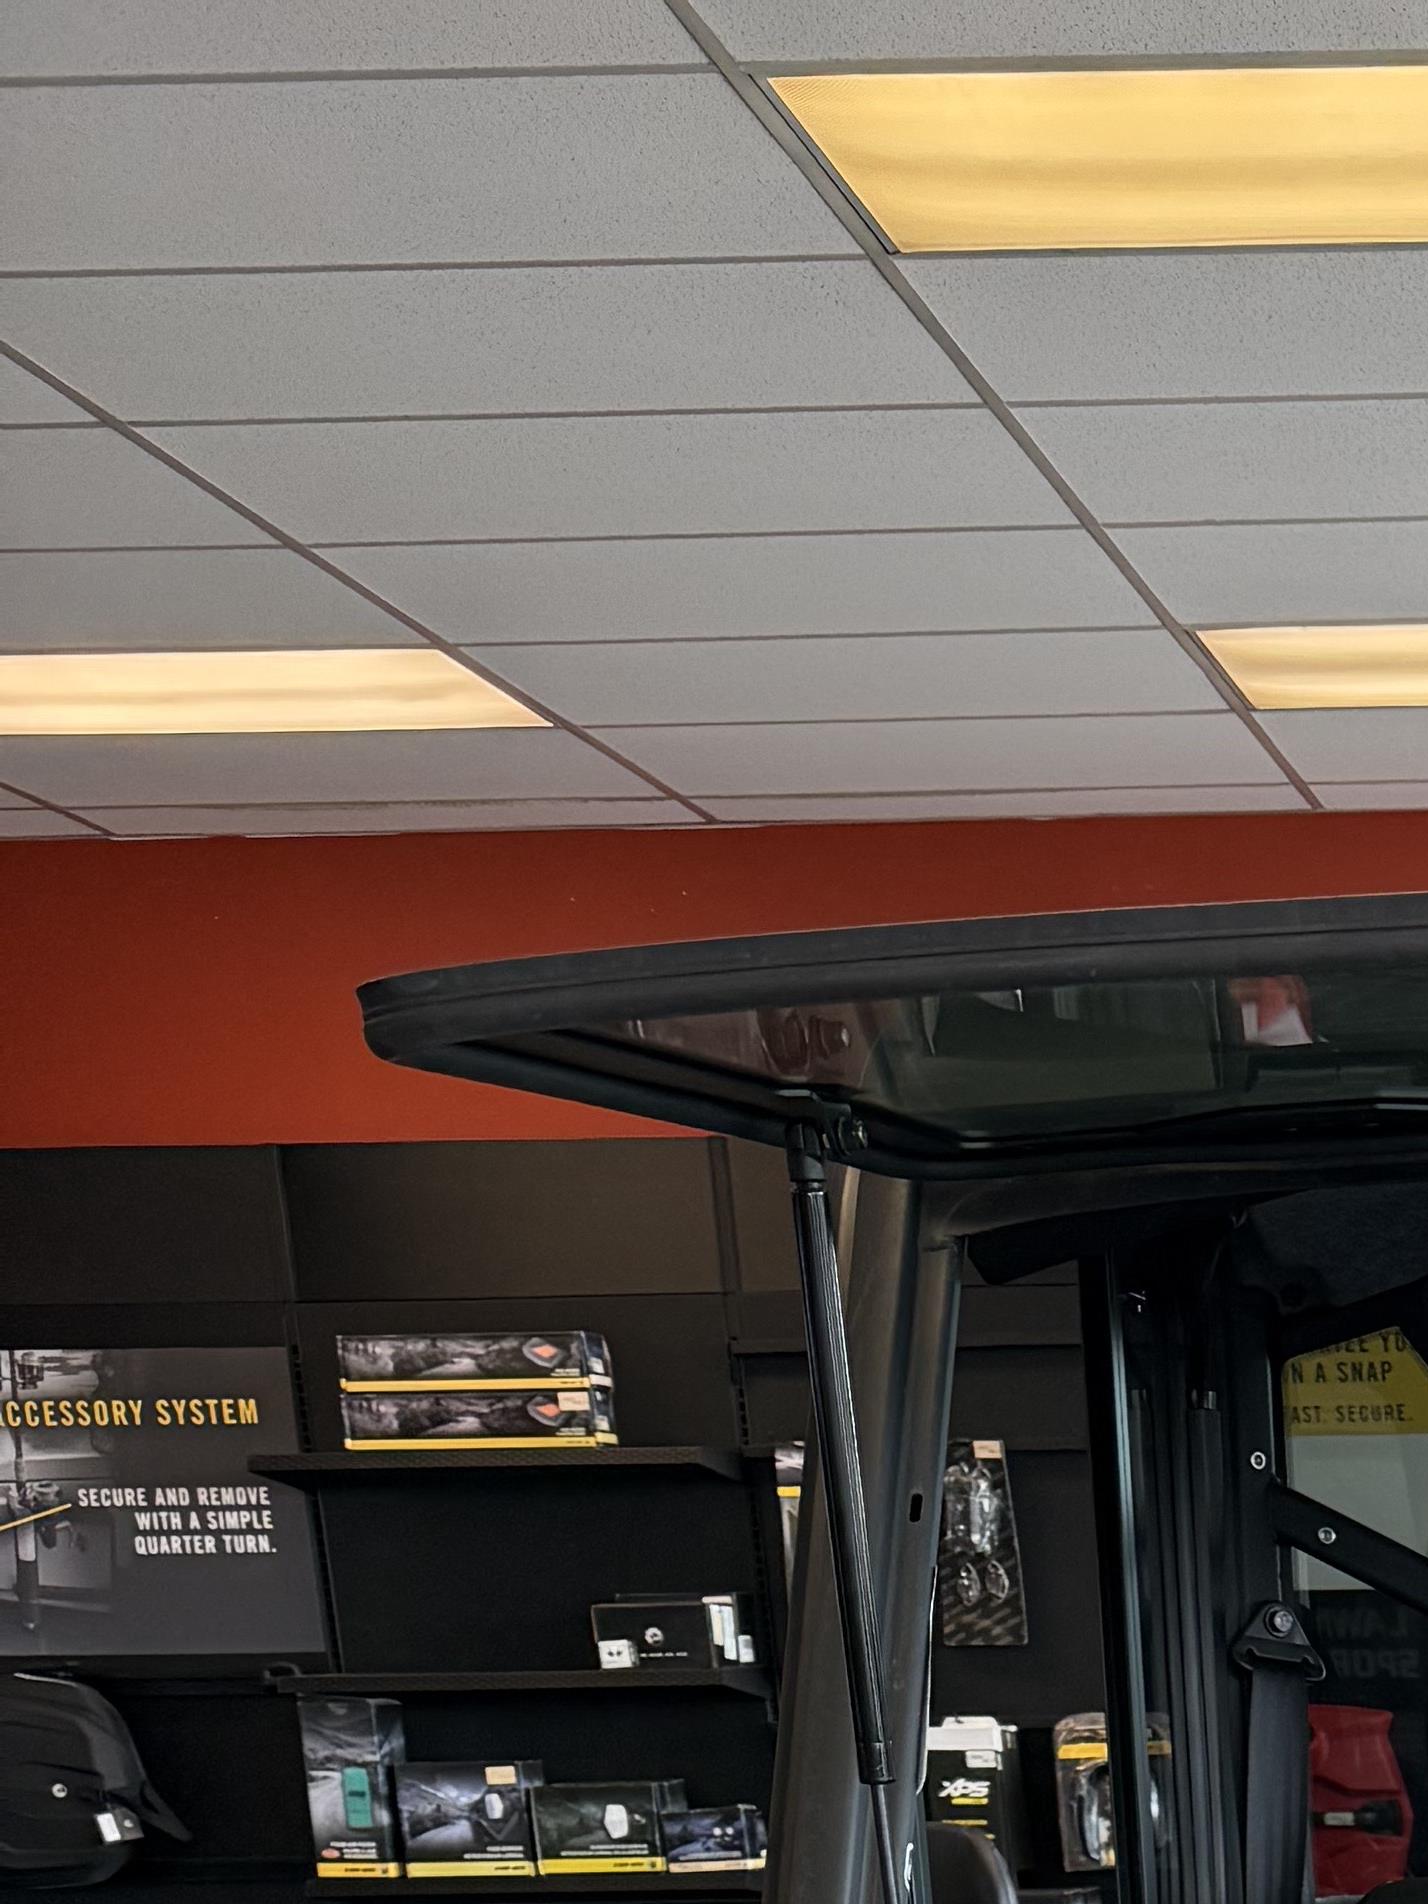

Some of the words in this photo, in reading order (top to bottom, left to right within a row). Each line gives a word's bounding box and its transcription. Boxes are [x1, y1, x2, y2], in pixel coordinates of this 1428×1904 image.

[1314, 1362, 1327, 1383] A
[1336, 1360, 1393, 1384] SNAP
[0, 1400, 143, 1428] CCESSORY
[155, 1399, 259, 1426] SYSTEM
[77, 1487, 149, 1508] SECURE
[155, 1487, 190, 1507] AND
[196, 1486, 271, 1506] REMOVE
[135, 1511, 182, 1531] WITH
[189, 1511, 201, 1530] A
[207, 1509, 274, 1530] SIMPLE
[134, 1535, 217, 1556] QUARTER
[221, 1533, 277, 1553] TURN.
